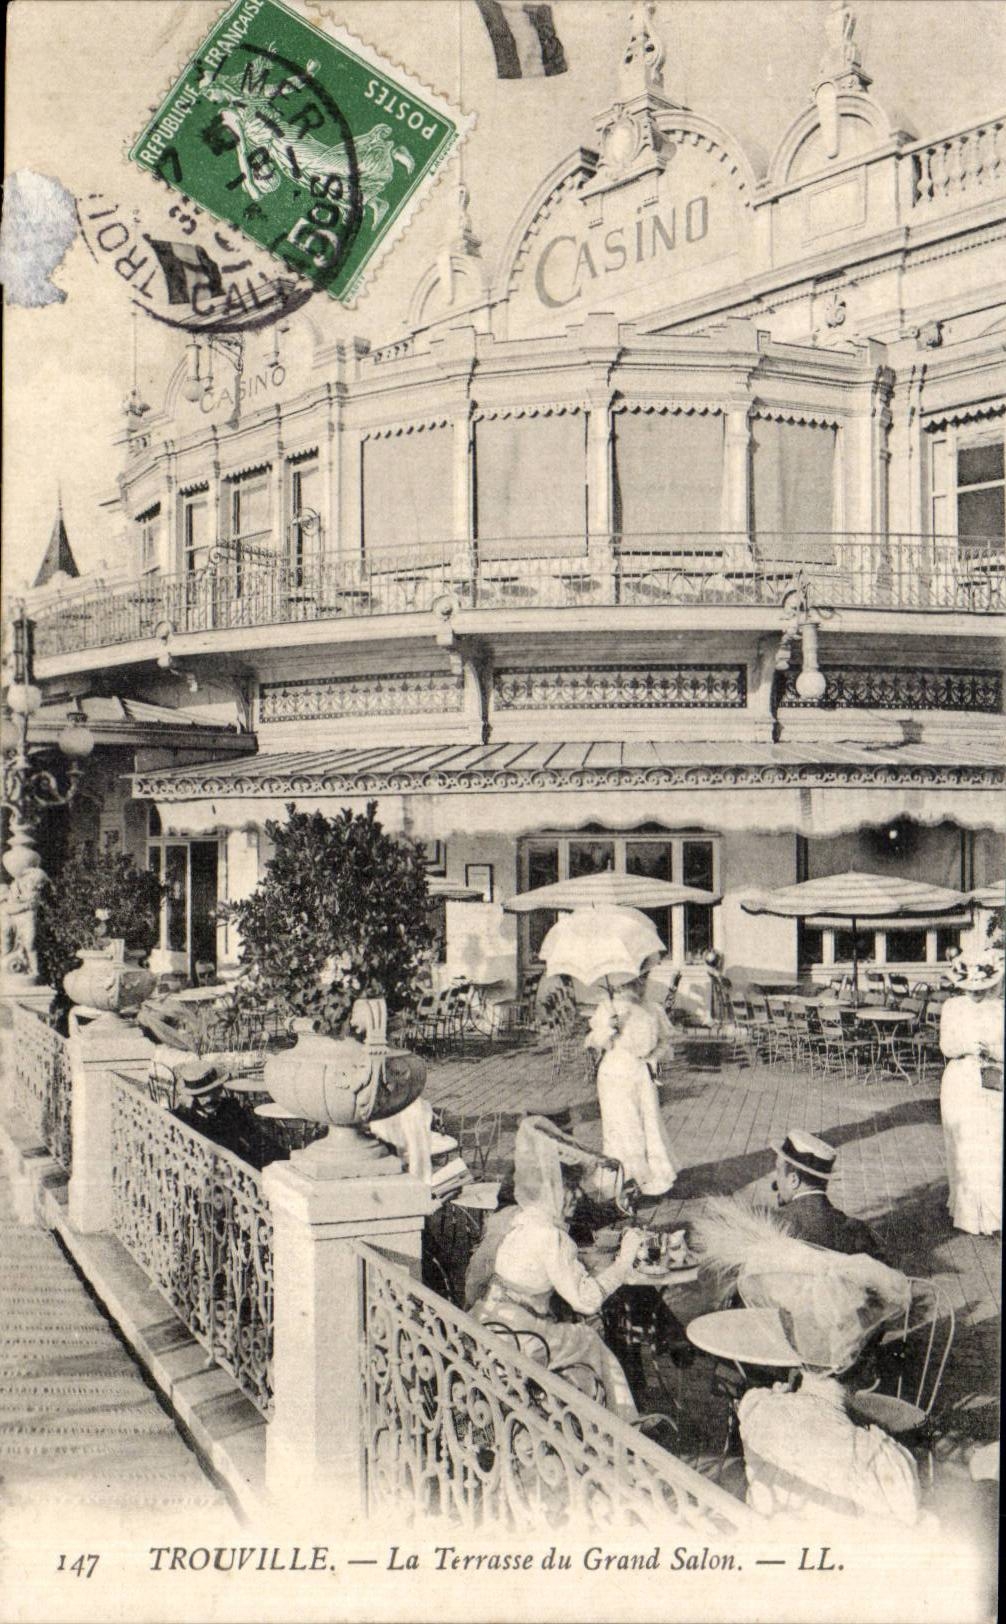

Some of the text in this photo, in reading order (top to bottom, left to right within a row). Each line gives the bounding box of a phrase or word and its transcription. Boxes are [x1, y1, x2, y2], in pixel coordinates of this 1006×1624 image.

[363, 78, 438, 140] POSTES
[535, 195, 709, 308] CASINO
[199, 364, 287, 414] CASINO
